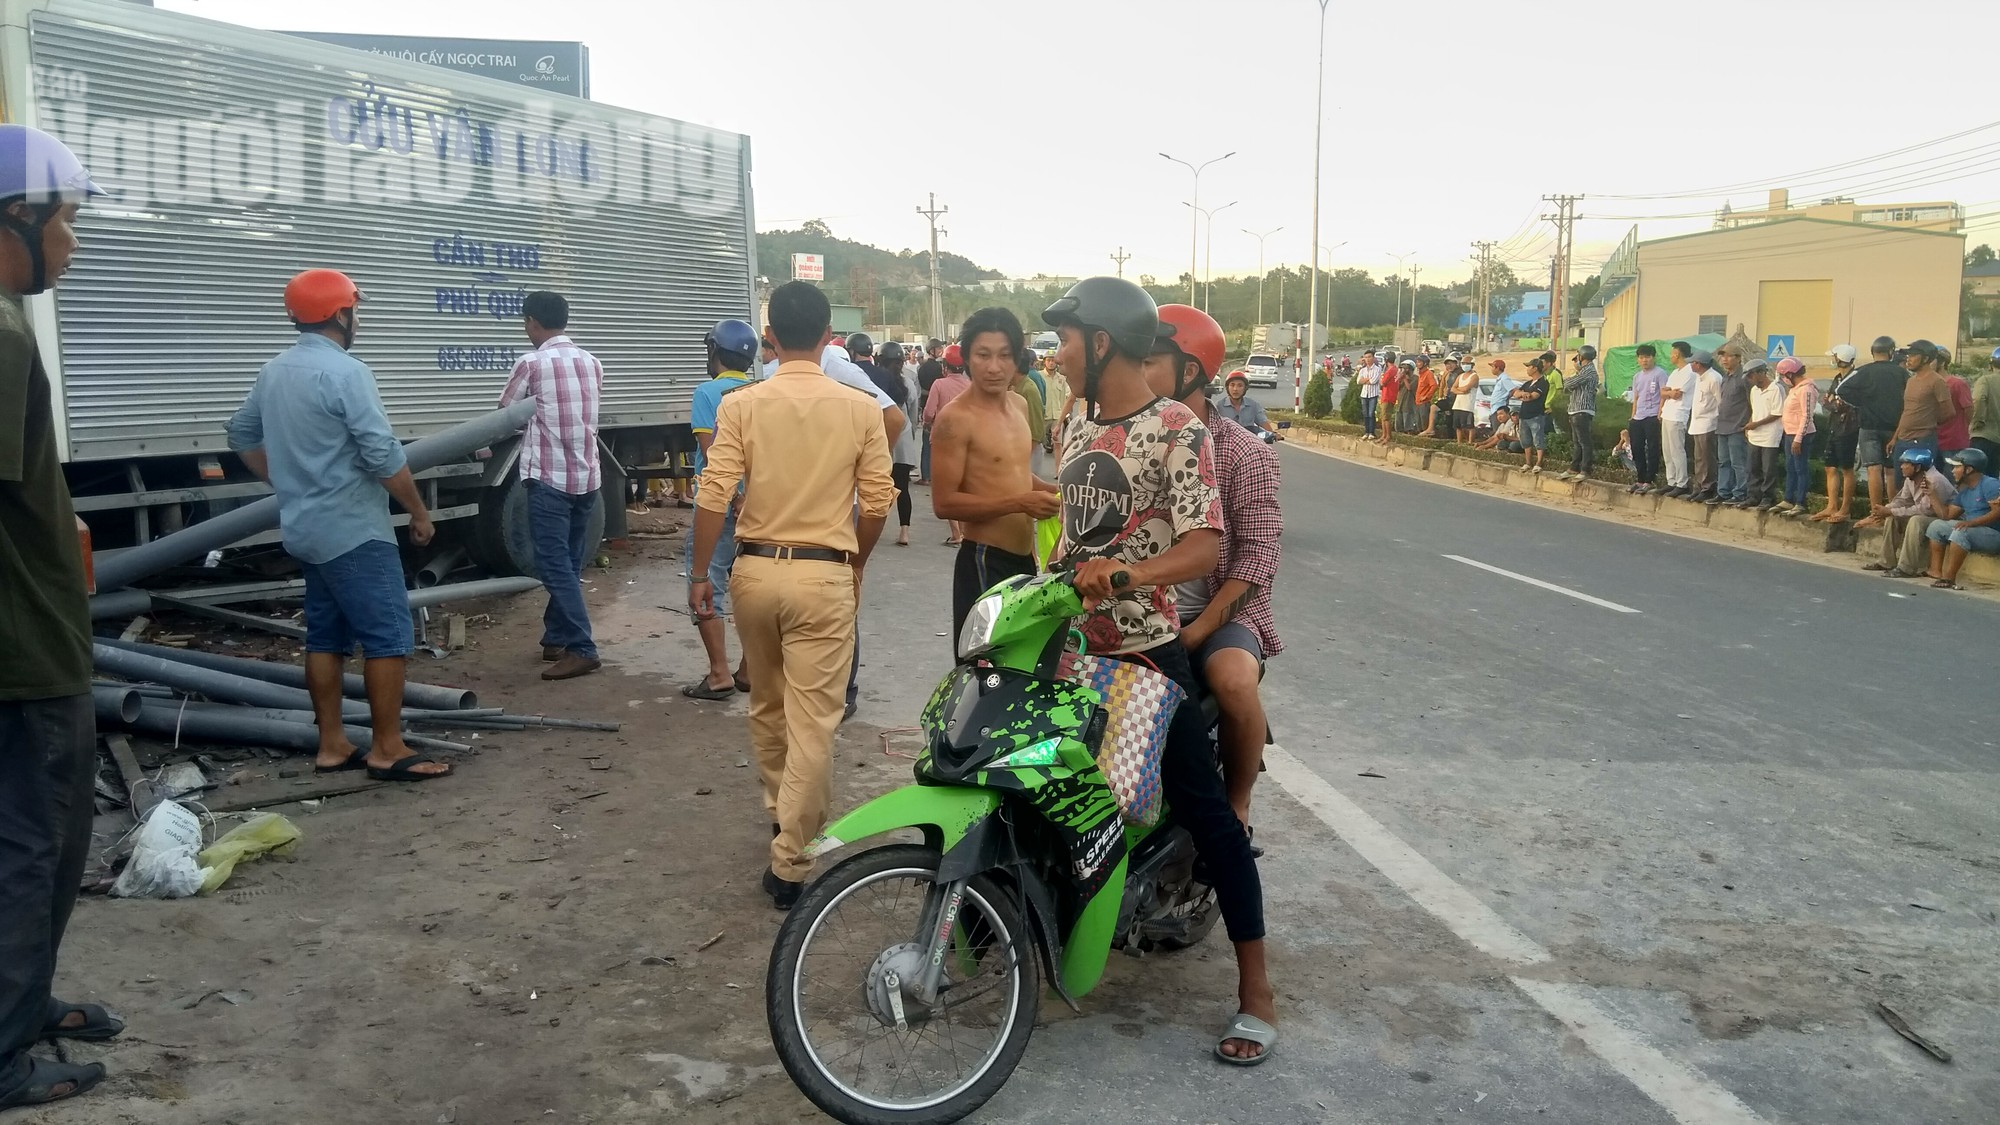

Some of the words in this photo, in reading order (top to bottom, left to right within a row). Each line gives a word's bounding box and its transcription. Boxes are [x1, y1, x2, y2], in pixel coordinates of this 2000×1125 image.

[419, 49, 444, 64] CẤY
[448, 53, 485, 68] NGỌC
[488, 55, 516, 67] TRAI
[552, 74, 570, 82] Pearl
[328, 80, 413, 155] CỬU
[515, 130, 601, 184] LONG
[492, 243, 540, 270] THƠ
[1060, 483, 1131, 517] LOREM
